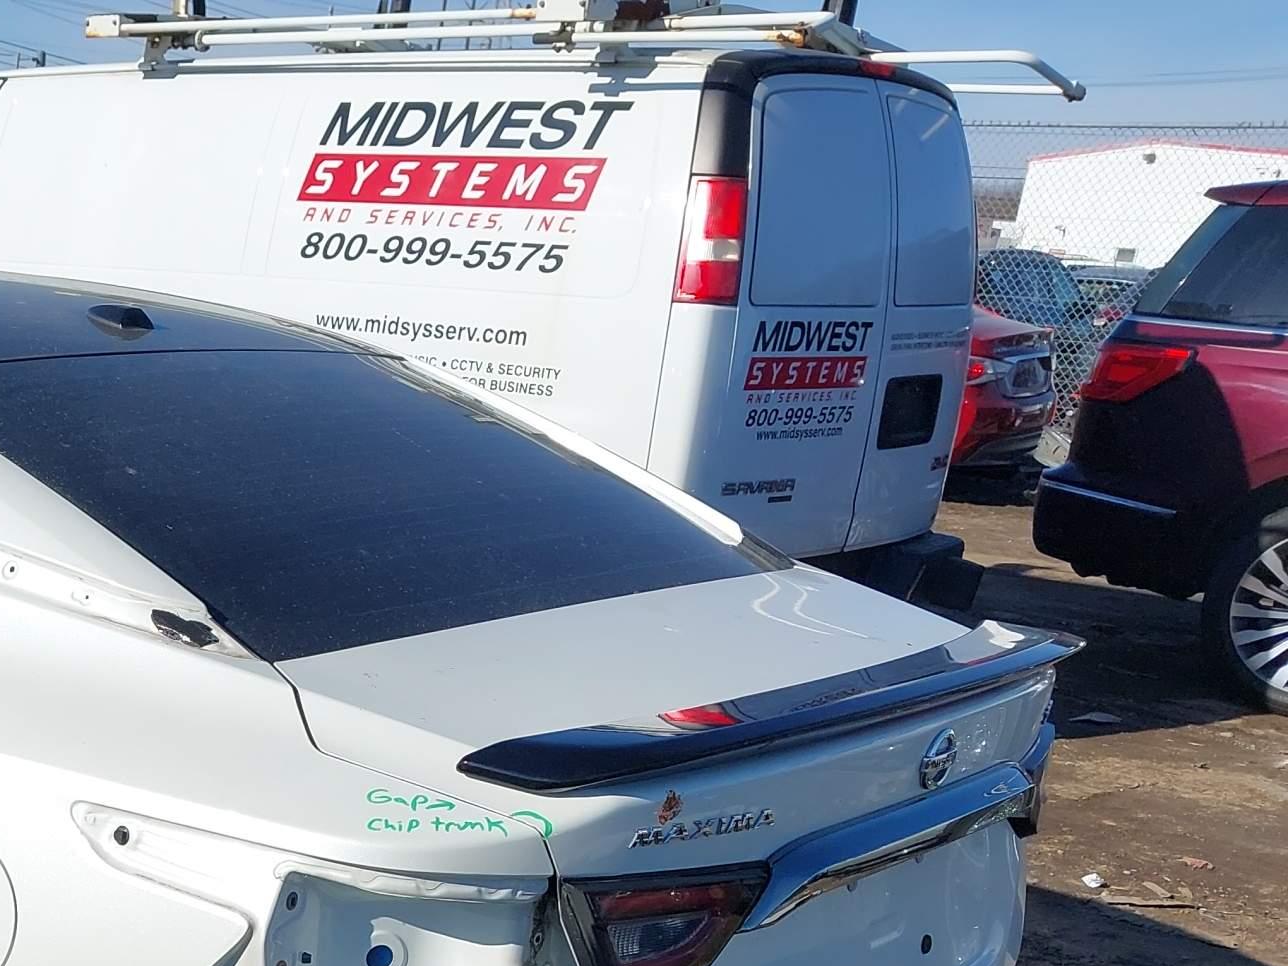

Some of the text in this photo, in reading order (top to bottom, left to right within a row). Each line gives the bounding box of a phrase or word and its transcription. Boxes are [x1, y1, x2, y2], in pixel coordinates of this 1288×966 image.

[319, 100, 635, 150] MIDWEST
[304, 159, 599, 203] SYSTEMS
[303, 207, 577, 233] AND SERVICES, INC.
[300, 231, 569, 274] 800-999-5575
[315, 313, 528, 347] www.midsysserv.com
[752, 320, 874, 353] MIDWEST
[450, 358, 483, 373] CCTV
[486, 362, 494, 374] &
[497, 363, 562, 380] SECURITY
[748, 360, 864, 386] SYSTEMS
[490, 379, 554, 397] BUSINESS
[745, 406, 855, 427] 800-999-5575
[757, 426, 843, 441] www.midsysserv.com
[366, 788, 429, 812] Gap
[430, 816, 508, 838] trunk
[628, 808, 775, 848] MAXIMA
